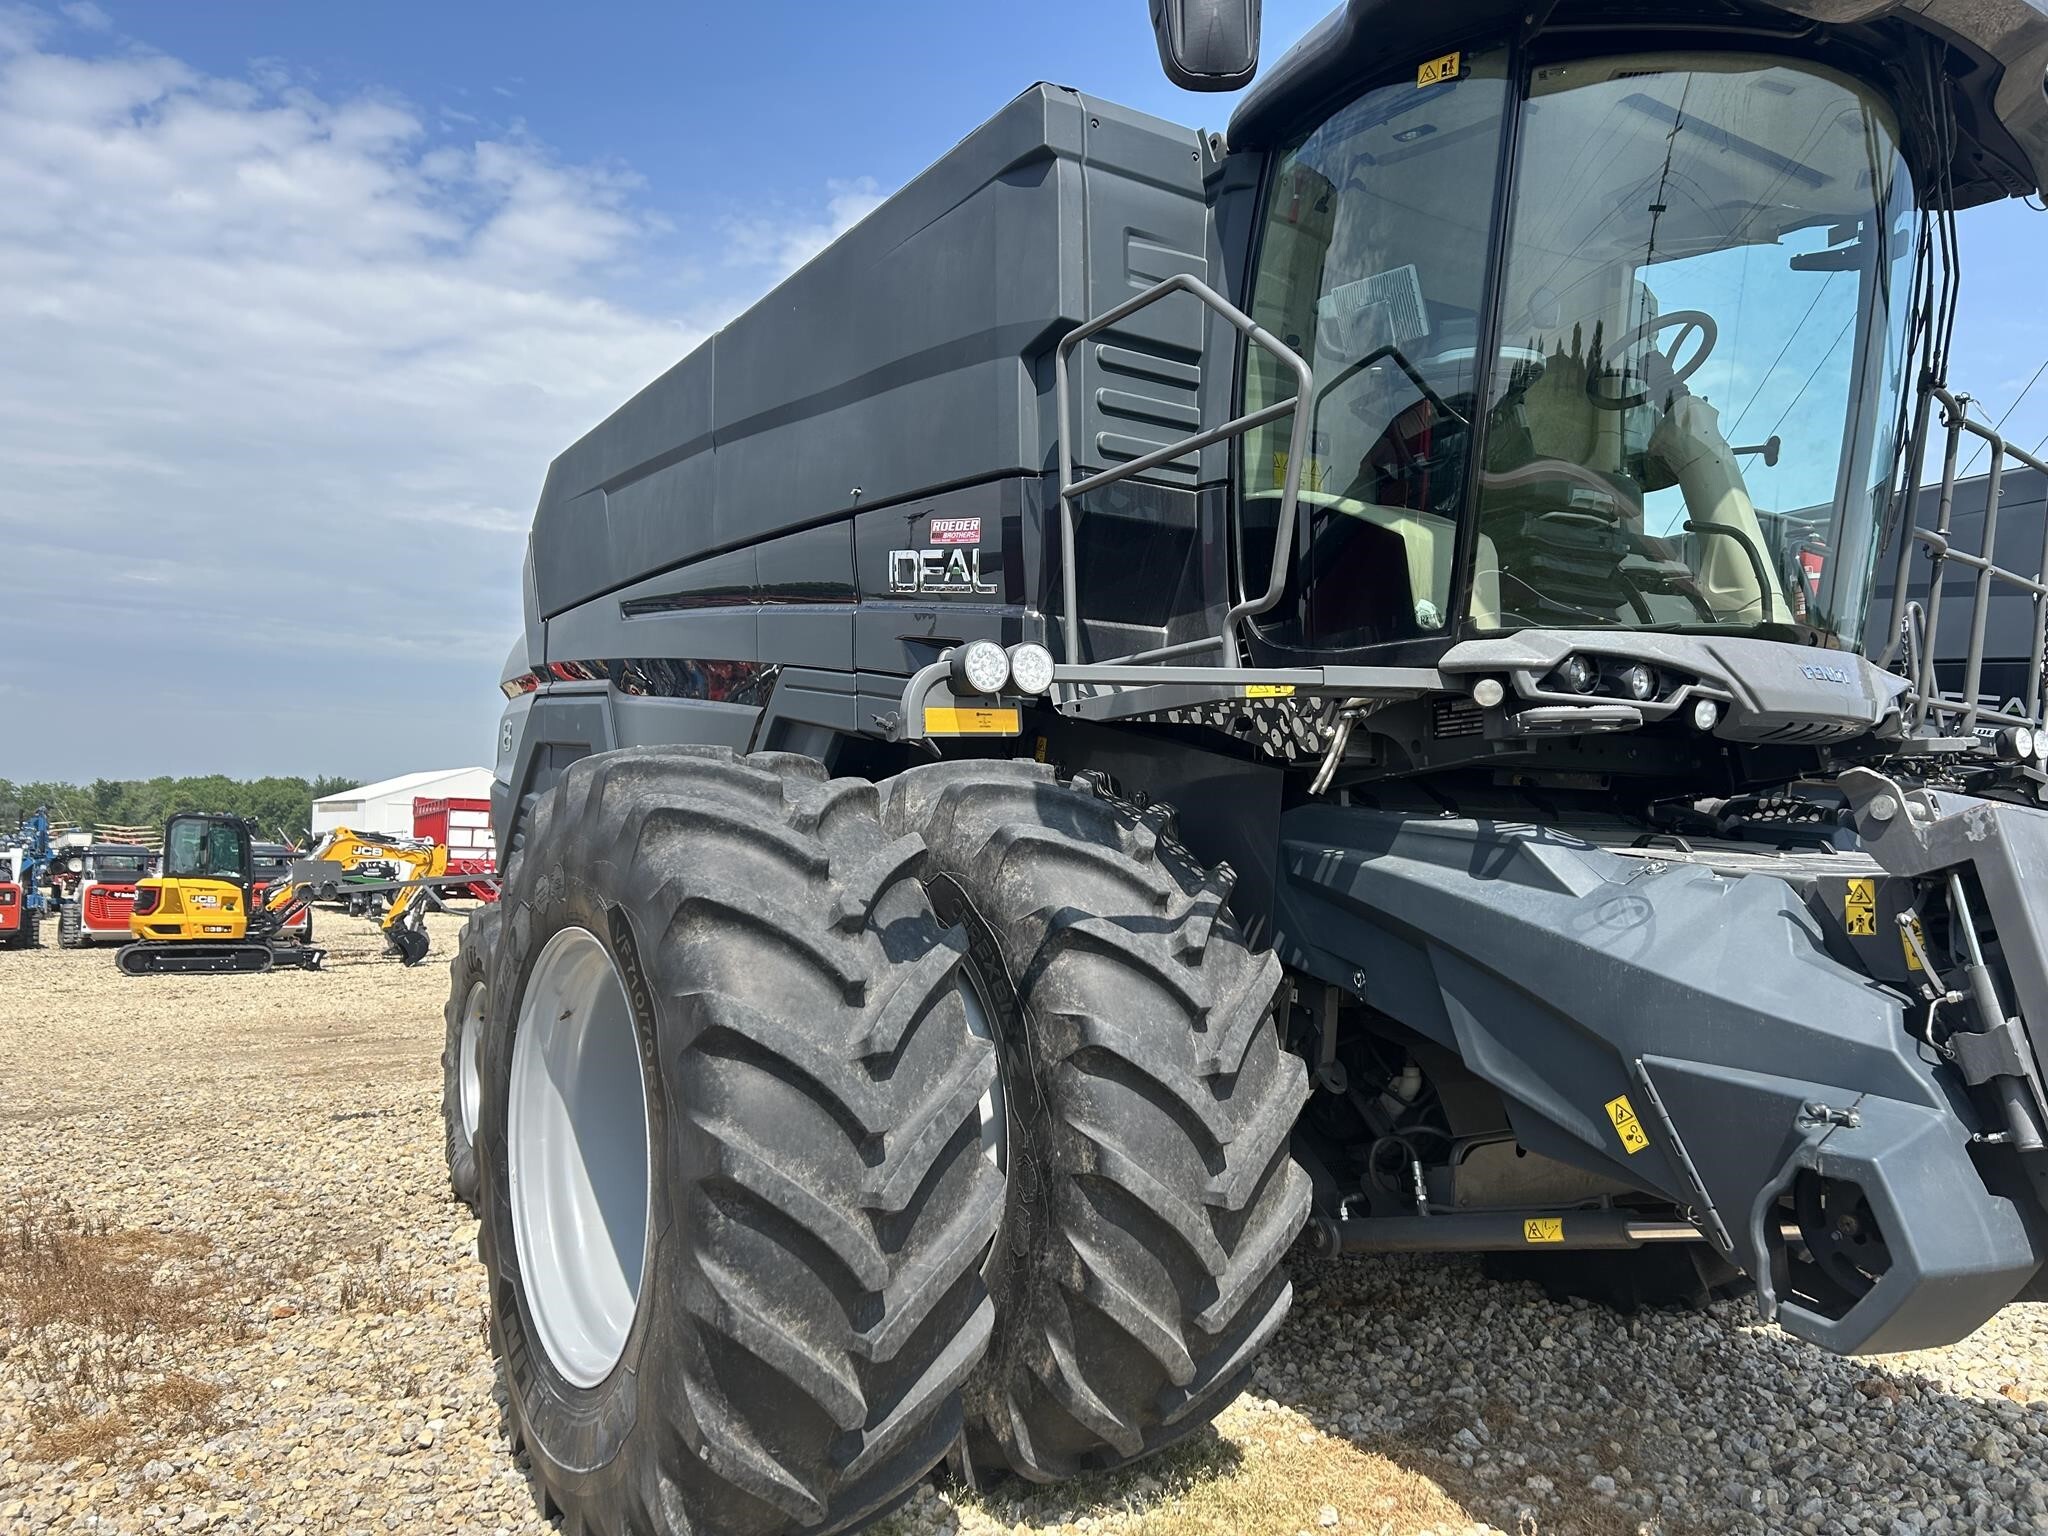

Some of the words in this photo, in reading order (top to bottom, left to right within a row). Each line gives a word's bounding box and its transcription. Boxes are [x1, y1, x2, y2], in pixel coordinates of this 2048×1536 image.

[932, 519, 979, 532] ROEDER
[942, 531, 976, 539] BROTHERS
[888, 548, 998, 594] IDEAL
[352, 845, 383, 857] JCB
[190, 895, 217, 904] JCB
